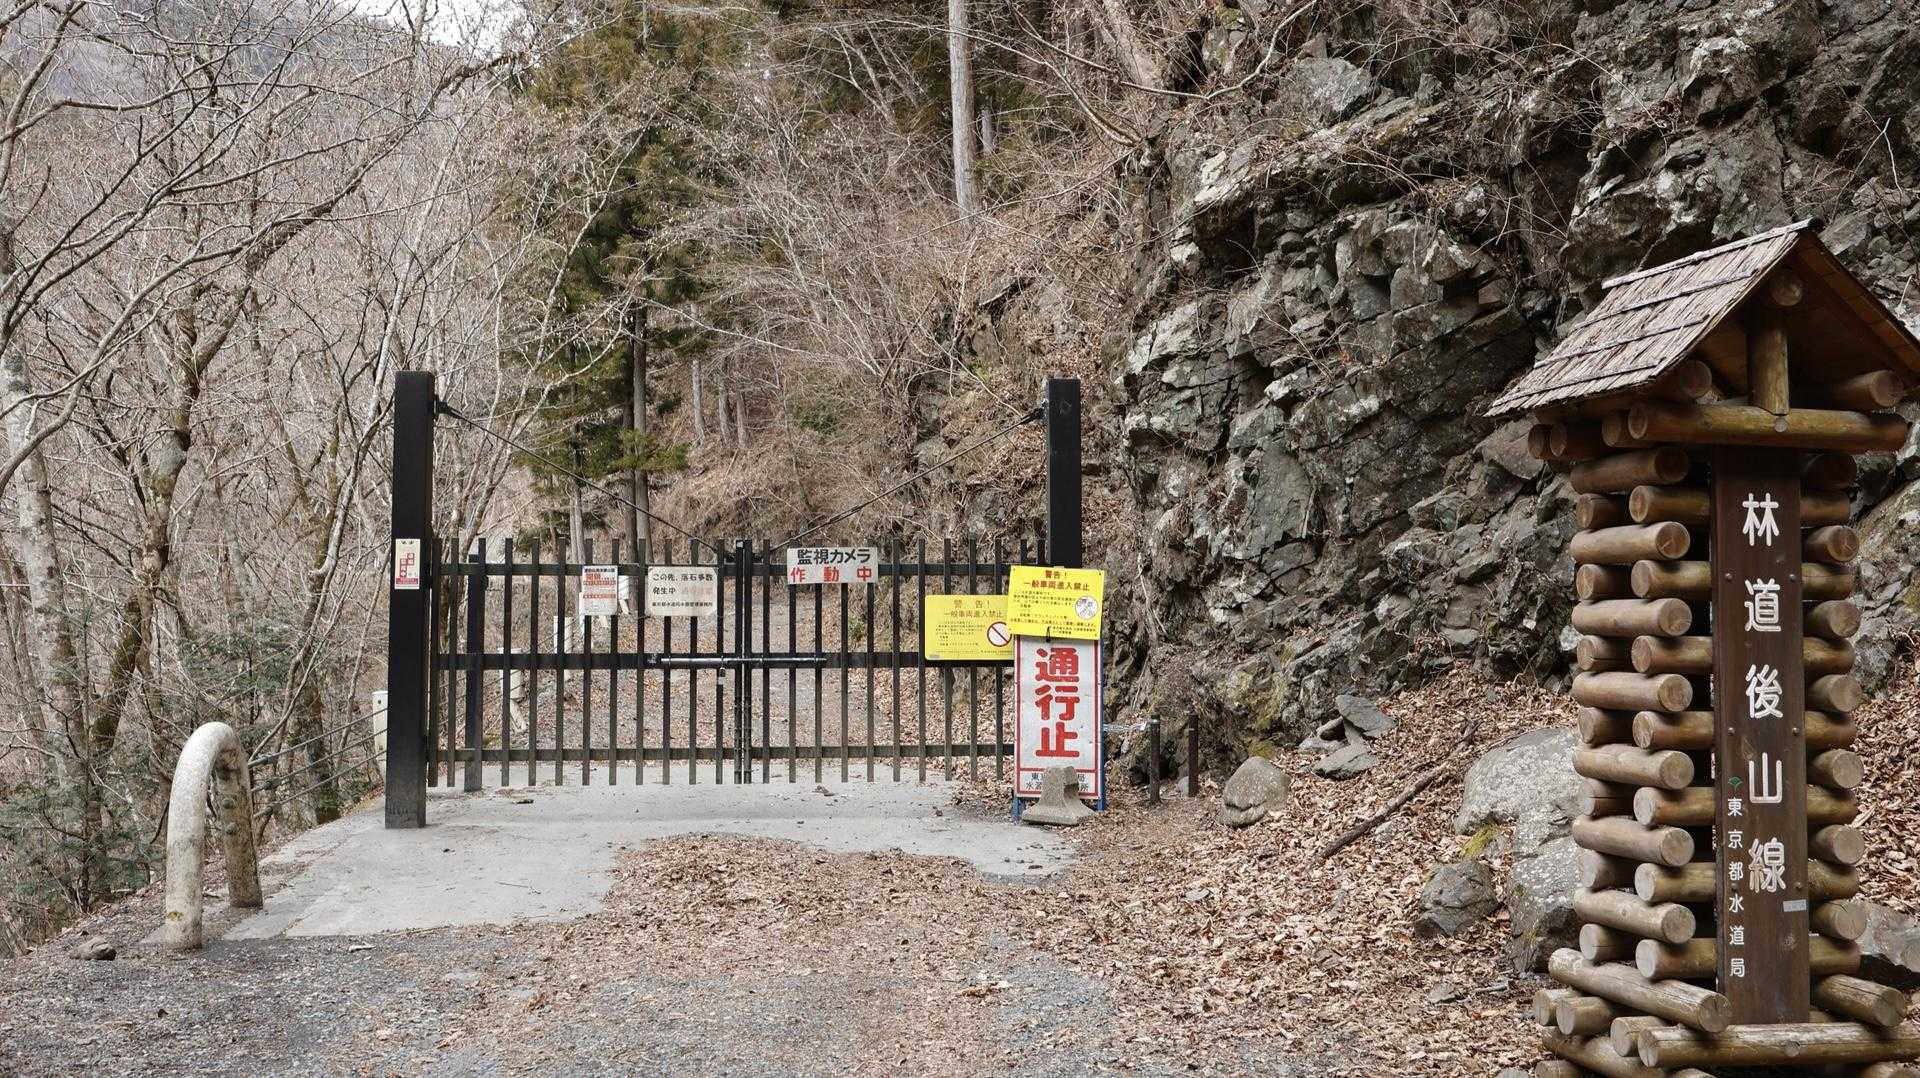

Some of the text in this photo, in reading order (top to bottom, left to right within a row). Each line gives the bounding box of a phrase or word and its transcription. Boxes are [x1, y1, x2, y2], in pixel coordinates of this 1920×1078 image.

[798, 548, 871, 565] 監視カメラ
[790, 566, 872, 583] 作動中
[653, 586, 676, 595] 発生中
[1024, 580, 1090, 591] 一般車両進入禁止
[1742, 492, 1786, 893] 林道後山線
[1035, 647, 1080, 758] 通行止
[1727, 797, 1746, 978] 東京都水道局
